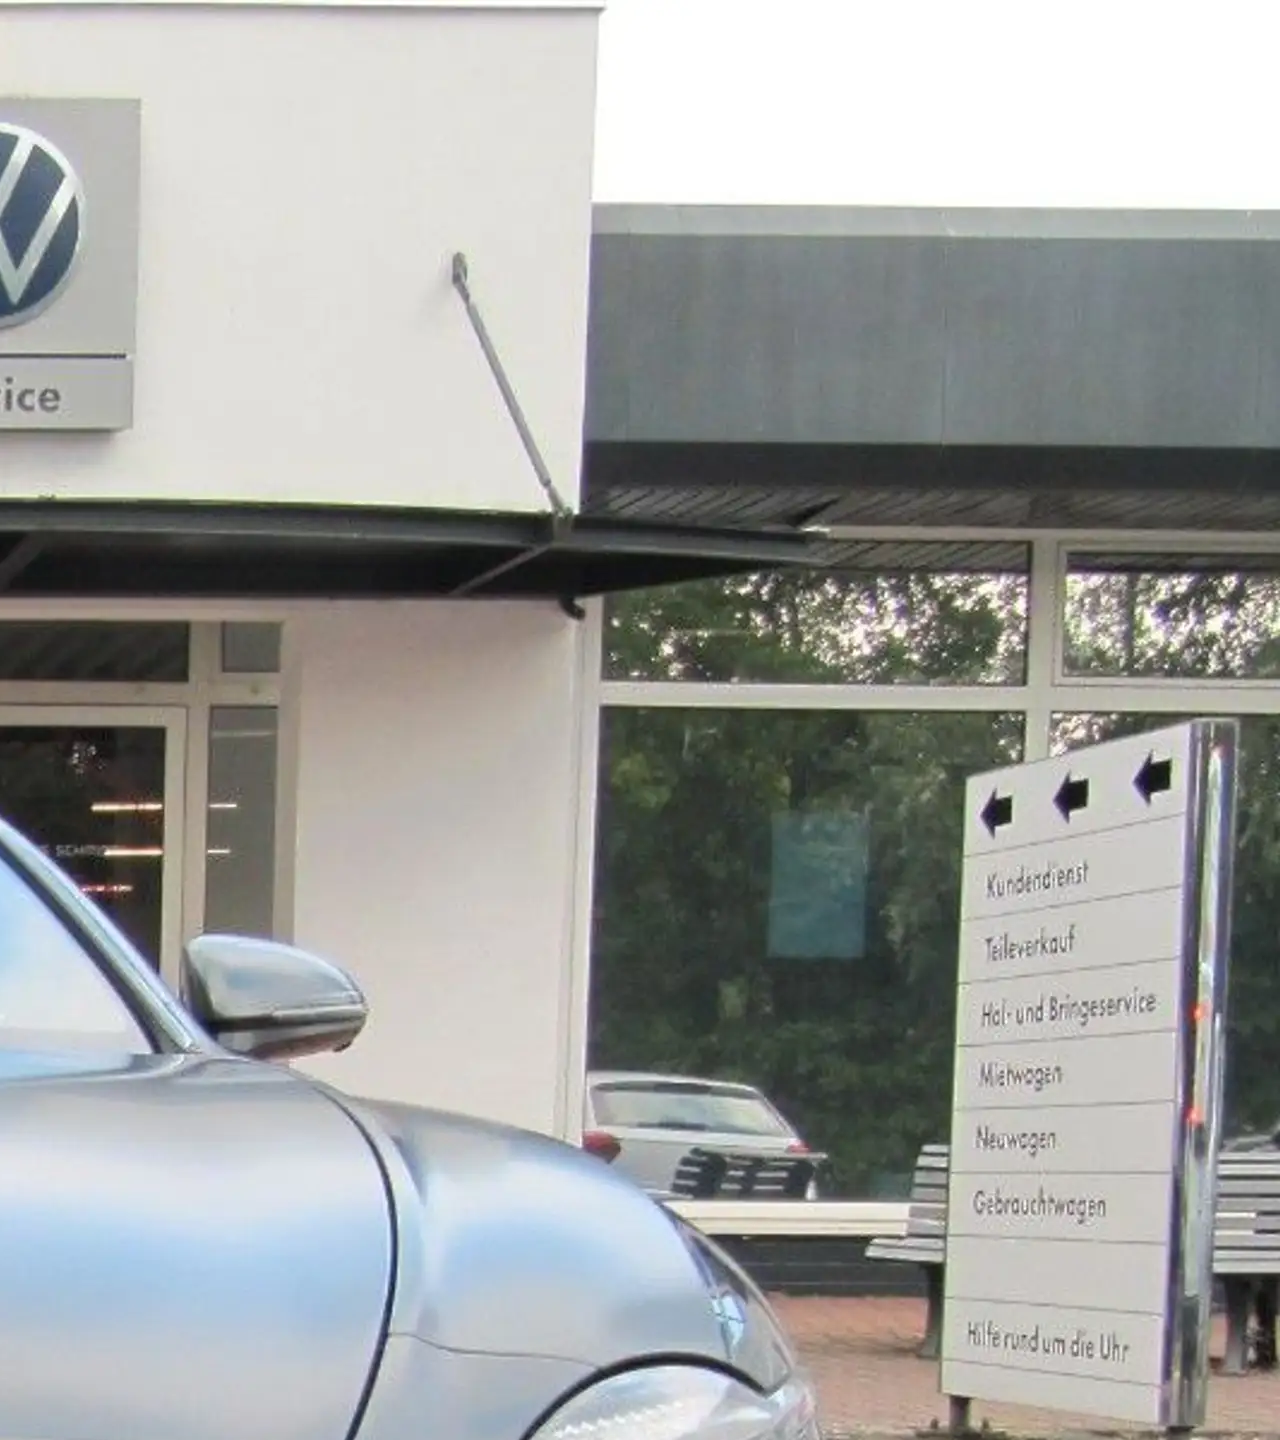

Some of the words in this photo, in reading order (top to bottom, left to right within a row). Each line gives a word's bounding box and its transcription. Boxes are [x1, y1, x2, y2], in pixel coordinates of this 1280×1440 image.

[986, 861, 1089, 898] Kundendienst
[984, 924, 1076, 962] Teileverkauf
[981, 998, 1011, 1027] Hol-
[1016, 993, 1044, 1025] und
[1049, 987, 1157, 1027] Bringeservice
[979, 1062, 1063, 1091] Mietwagen
[975, 1126, 1056, 1157] Neuwagen
[973, 1186, 1107, 1224] Gebrauchtwagen
[967, 1321, 1000, 1348] Hilfe
[1003, 1325, 1039, 1352] rund
[1042, 1336, 1065, 1354] um
[1070, 1328, 1094, 1359] die
[1099, 1331, 1130, 1363] Uhr
